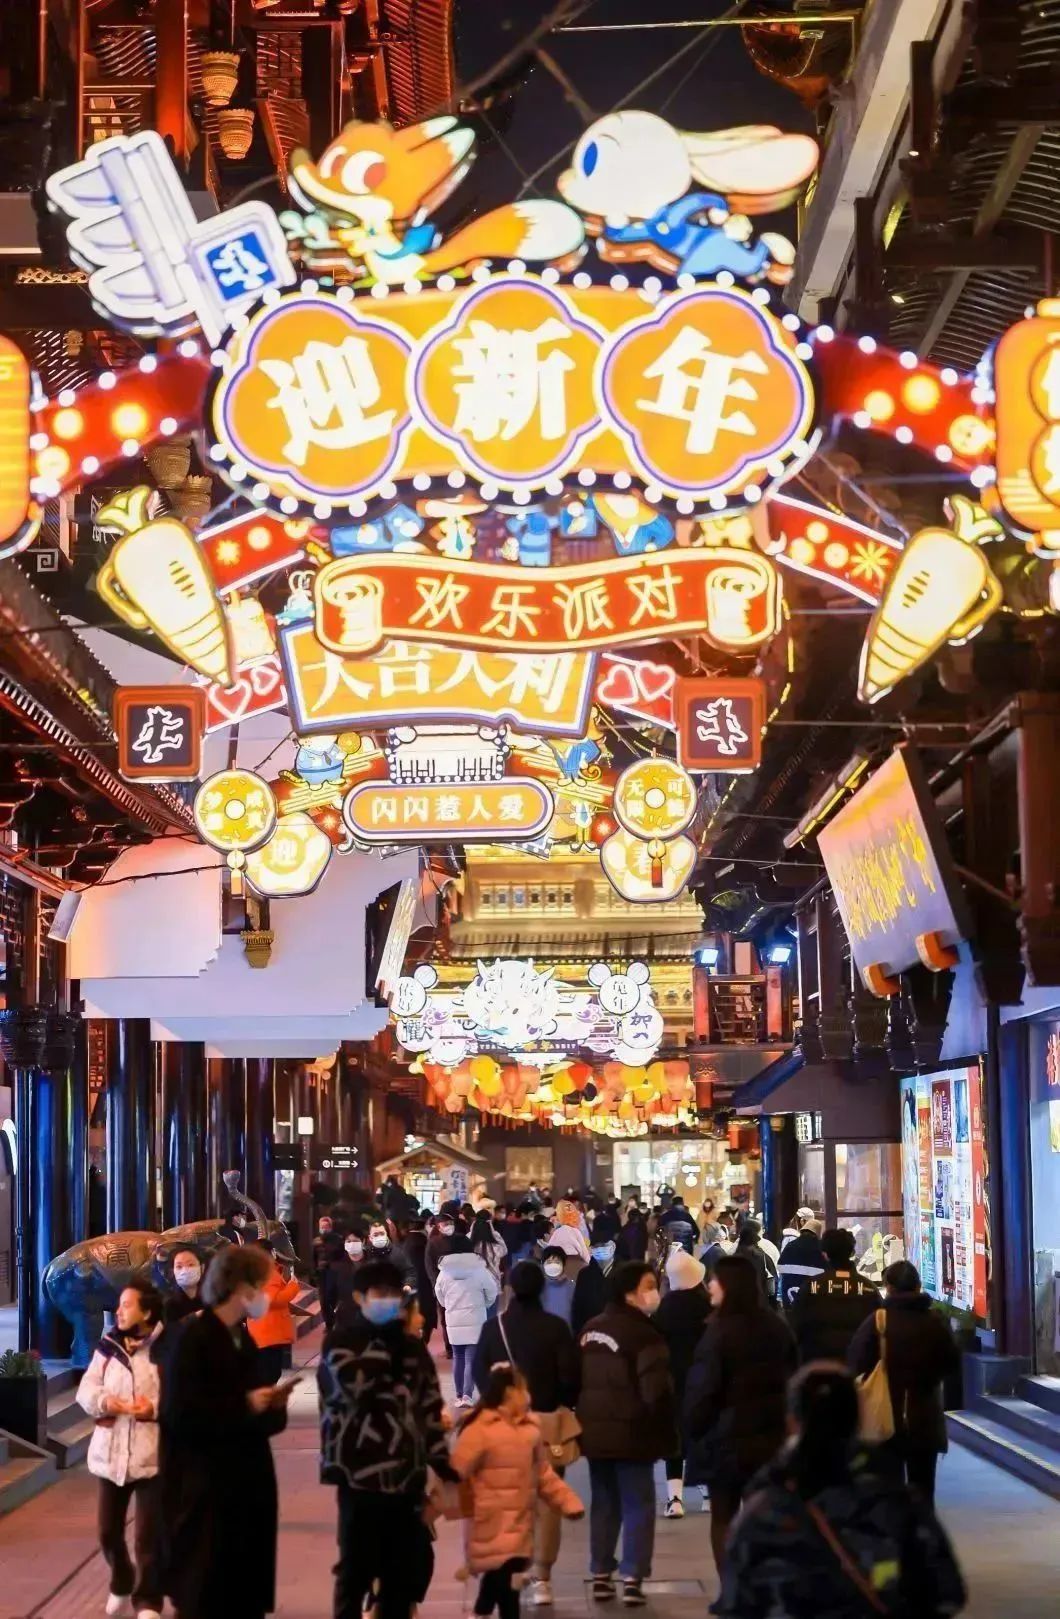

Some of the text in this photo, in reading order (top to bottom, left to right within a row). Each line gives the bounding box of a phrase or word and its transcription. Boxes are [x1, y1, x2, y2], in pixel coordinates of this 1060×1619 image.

[261, 318, 769, 466] 迎新年
[409, 565, 683, 639] 欢乐派对
[371, 794, 525, 824] 闪闪惹人爱
